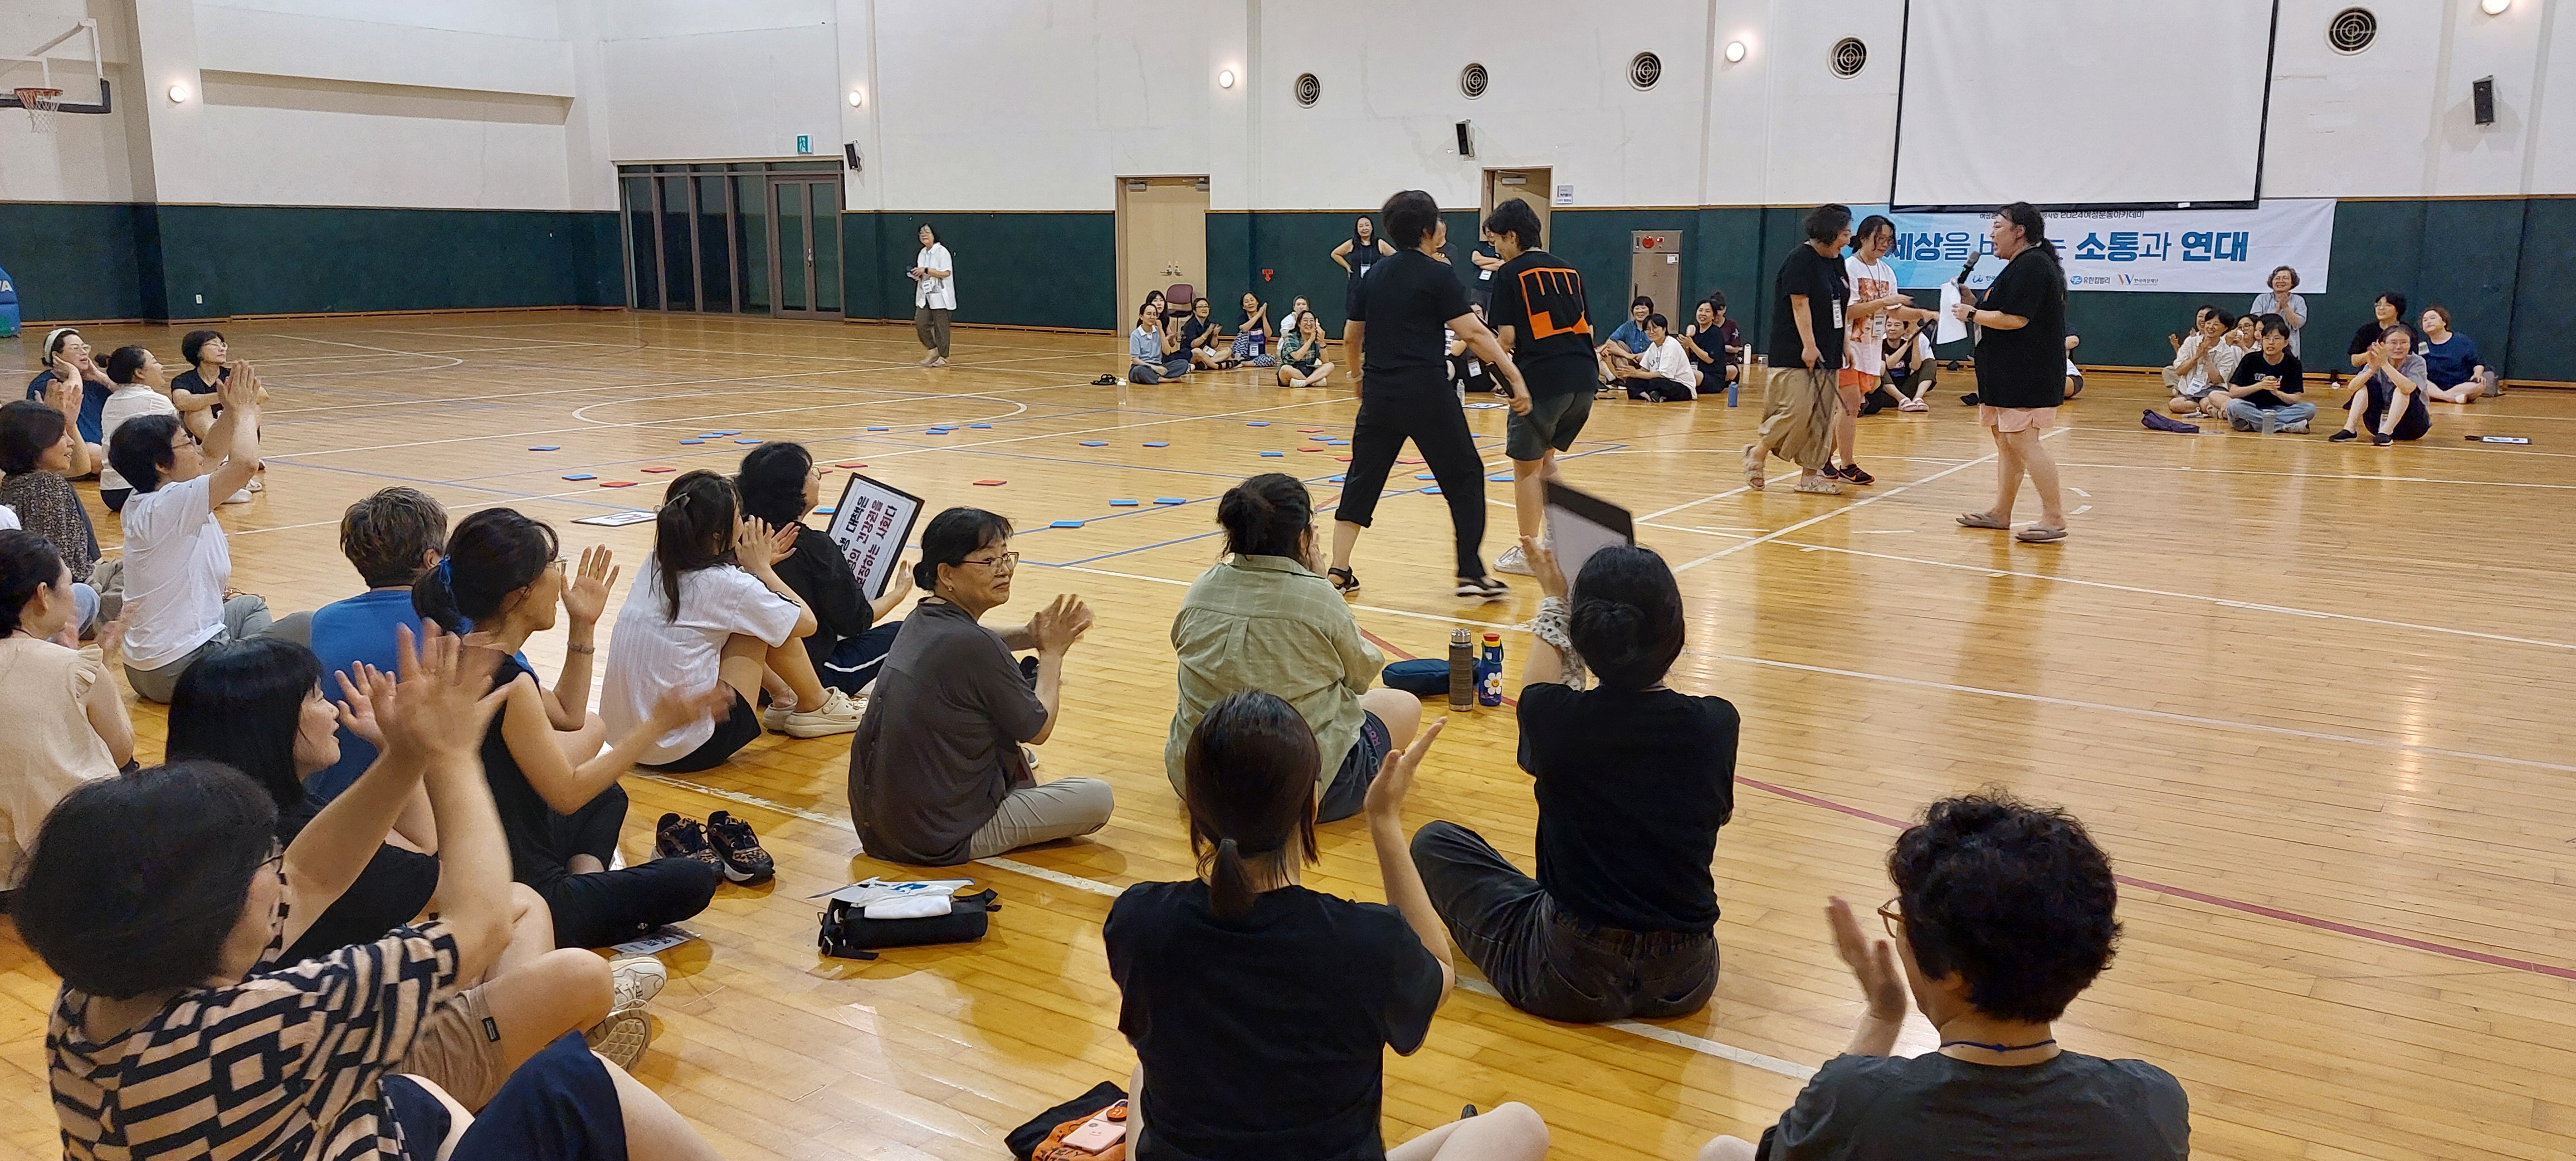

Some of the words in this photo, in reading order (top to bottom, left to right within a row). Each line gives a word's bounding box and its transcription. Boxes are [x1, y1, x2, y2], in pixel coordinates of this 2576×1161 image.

[2075, 231, 2172, 261] 소통과
[2181, 231, 2249, 262] 연대
[845, 495, 870, 534] 대책은
[856, 499, 884, 545] 건강권을
[875, 504, 897, 540] 사회다
